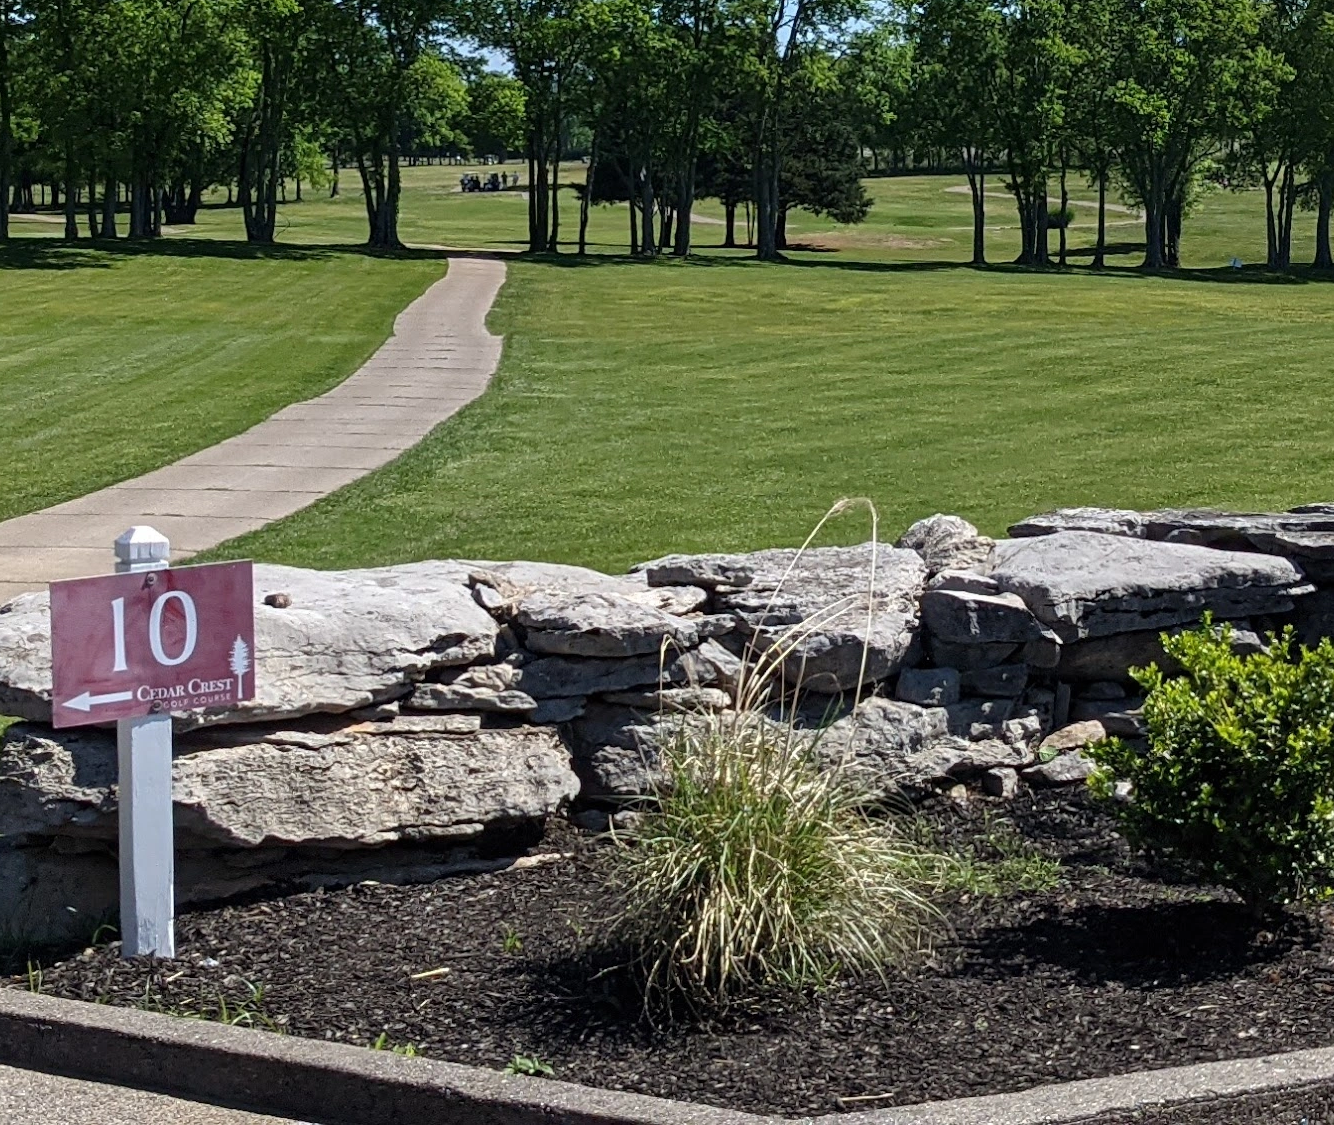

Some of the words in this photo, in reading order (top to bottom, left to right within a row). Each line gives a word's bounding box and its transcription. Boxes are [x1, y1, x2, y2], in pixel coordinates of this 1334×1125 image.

[111, 590, 197, 672] 10
[137, 685, 185, 702] CEDAR
[188, 678, 234, 695] CREST
[163, 699, 189, 709] GOLF
[193, 693, 231, 705] COURSE
